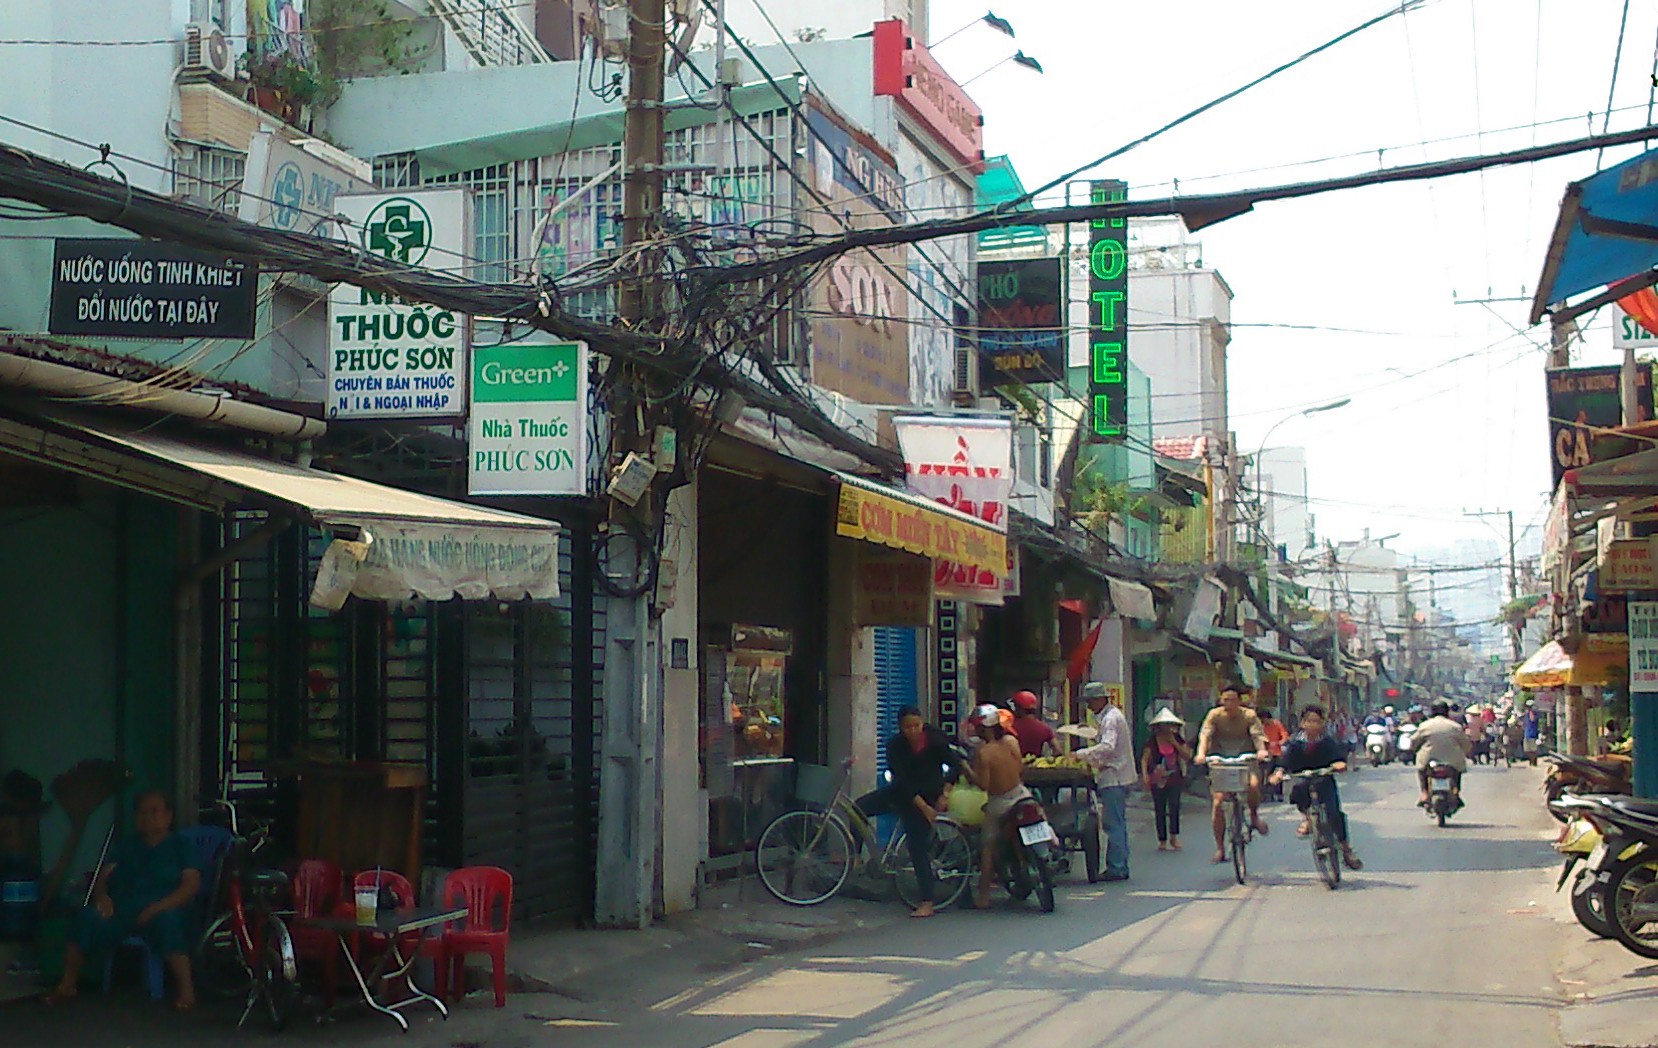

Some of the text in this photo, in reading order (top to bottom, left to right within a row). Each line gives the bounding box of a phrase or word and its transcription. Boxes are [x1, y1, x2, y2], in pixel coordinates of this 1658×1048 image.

[60, 255, 104, 283] NƯỚC
[108, 252, 152, 284] UỐNG
[157, 261, 191, 285] TINH
[78, 289, 220, 326] ĐỔI NƯỚC TẠI ĐÂY
[1091, 188, 1125, 436] HOTEL
[336, 305, 455, 341] THUỐC
[335, 342, 455, 371] PHÚC SƠN
[335, 372, 455, 392] CHUYÊN BÁN THUỐC
[374, 395, 412, 411] NGOẠI
[416, 393, 449, 411] NHẬP
[482, 416, 568, 438] Nhà Thuốc
[475, 444, 574, 471] PHÚC SƠN
